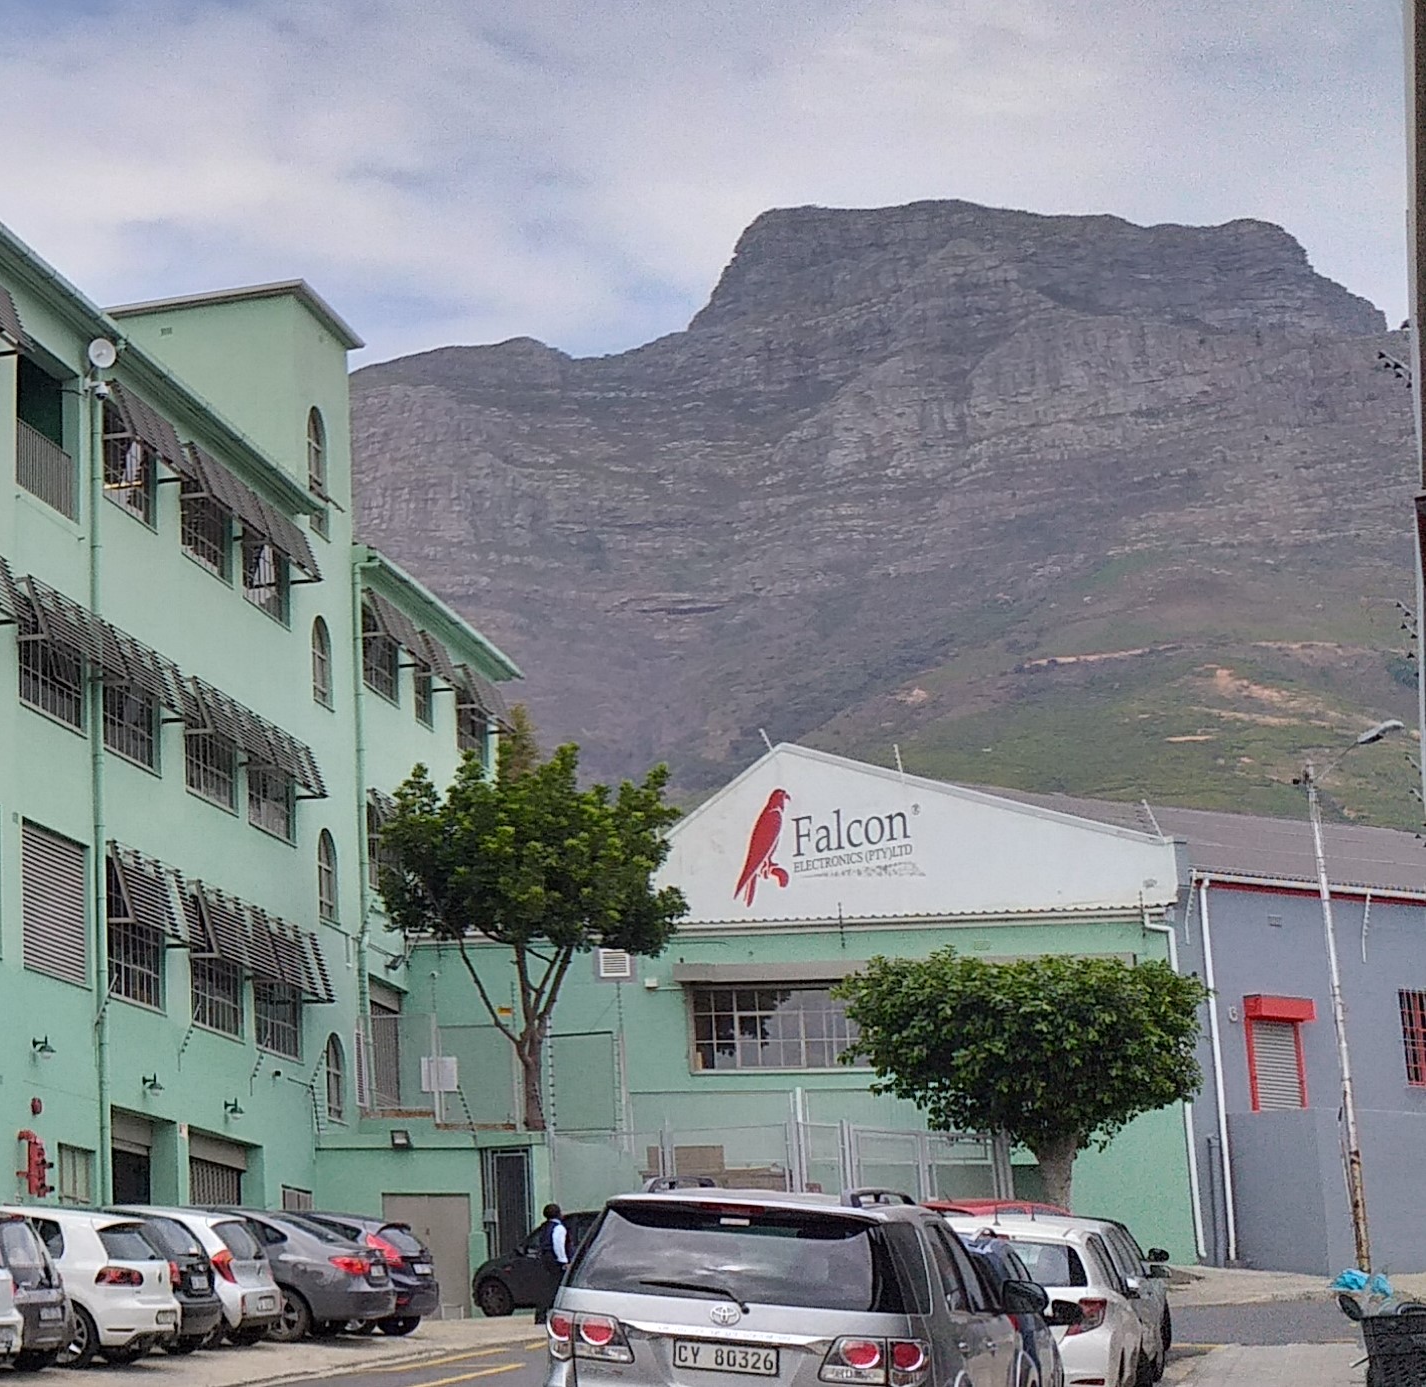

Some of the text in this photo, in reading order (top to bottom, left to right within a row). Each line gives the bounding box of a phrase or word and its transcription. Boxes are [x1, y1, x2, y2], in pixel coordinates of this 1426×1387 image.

[791, 808, 911, 857] Falcon
[793, 851, 864, 873] ELECTRONICS
[678, 1345, 774, 1371] CY 80326
